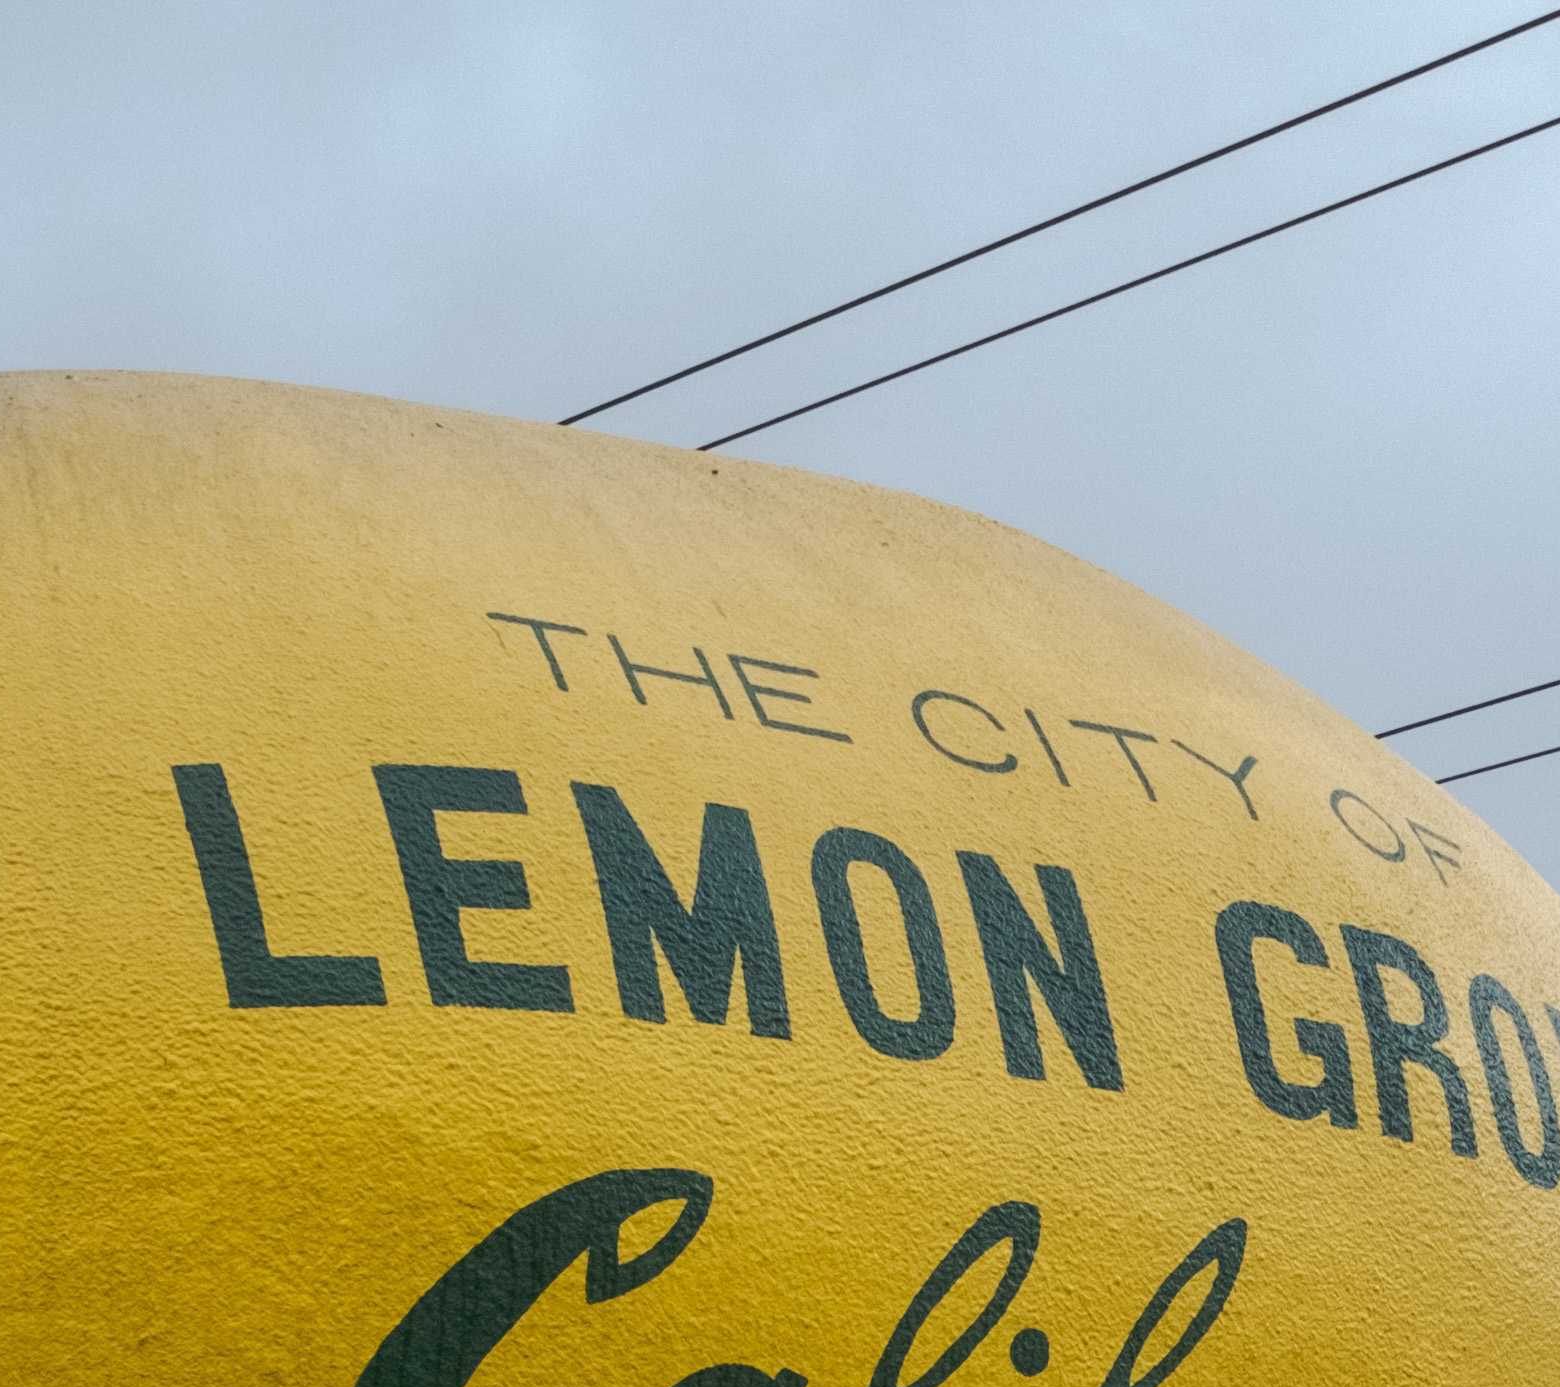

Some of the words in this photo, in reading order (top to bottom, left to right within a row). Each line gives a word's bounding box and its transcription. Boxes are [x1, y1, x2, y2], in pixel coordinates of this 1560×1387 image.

[486, 611, 852, 744] THE
[913, 688, 1258, 821] CITY
[1329, 788, 1461, 888] OF
[171, 762, 1125, 1092] LEMON
